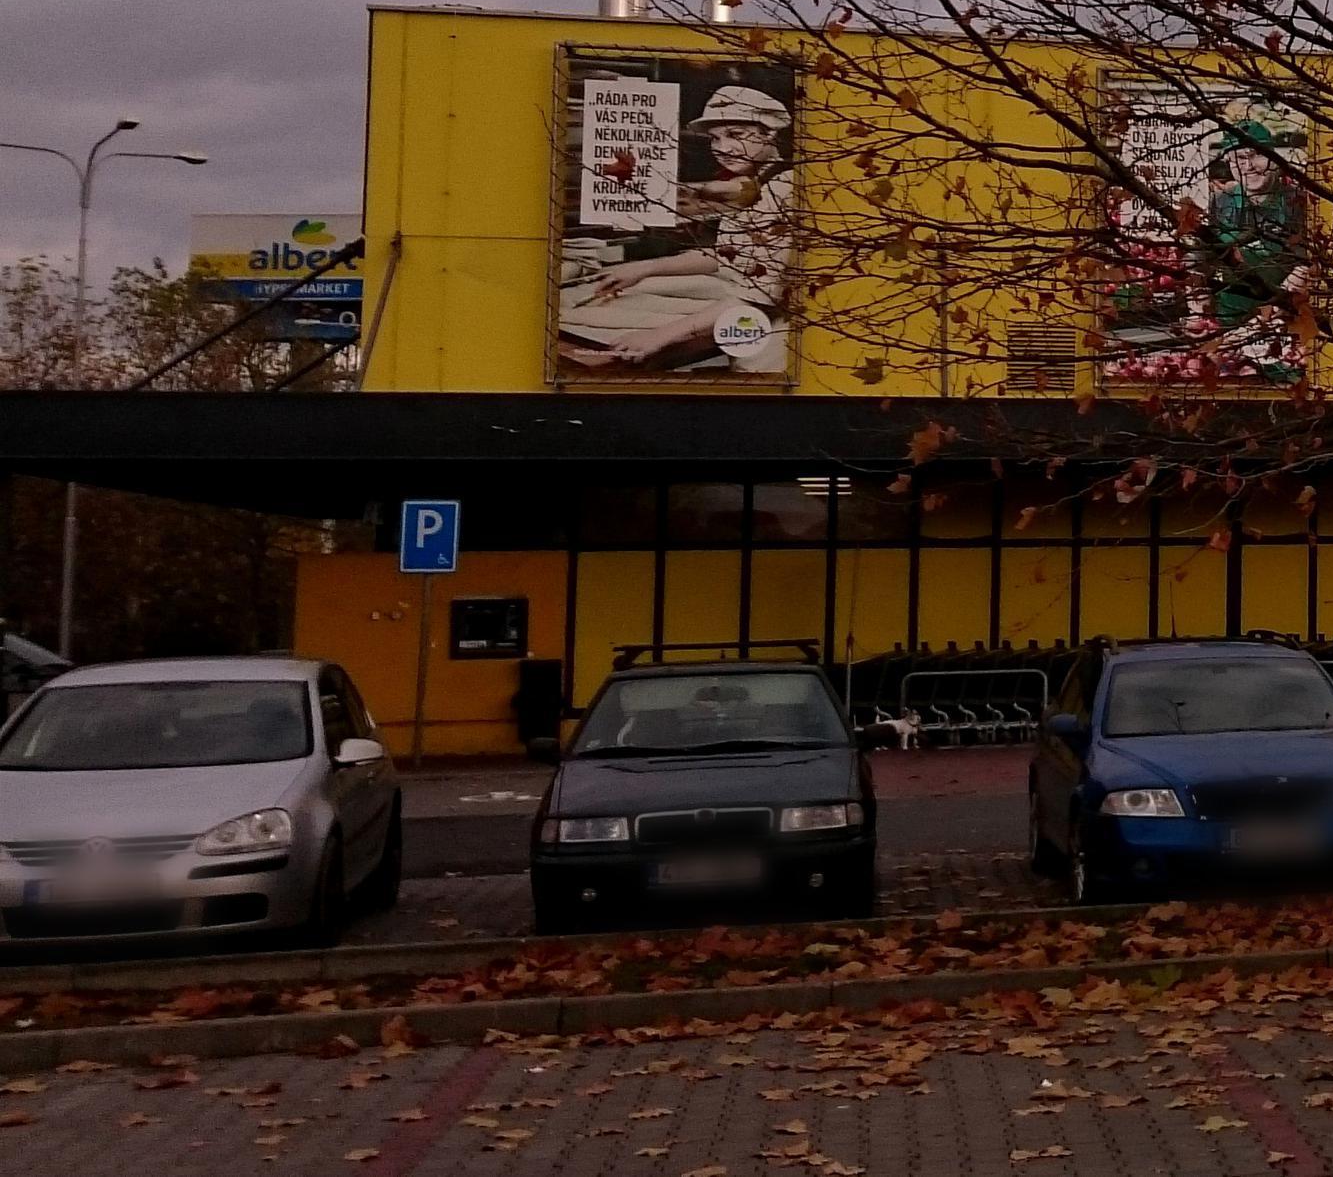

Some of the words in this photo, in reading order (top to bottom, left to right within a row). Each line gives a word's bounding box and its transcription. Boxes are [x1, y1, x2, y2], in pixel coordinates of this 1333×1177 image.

[632, 94, 657, 107] PRO
[595, 107, 617, 123] VÁS
[594, 161, 652, 178] OENÉ
[1132, 164, 1177, 178] OESLI
[255, 283, 351, 296] HYPMARKET
[720, 326, 766, 338] albert
[416, 509, 444, 549] P
